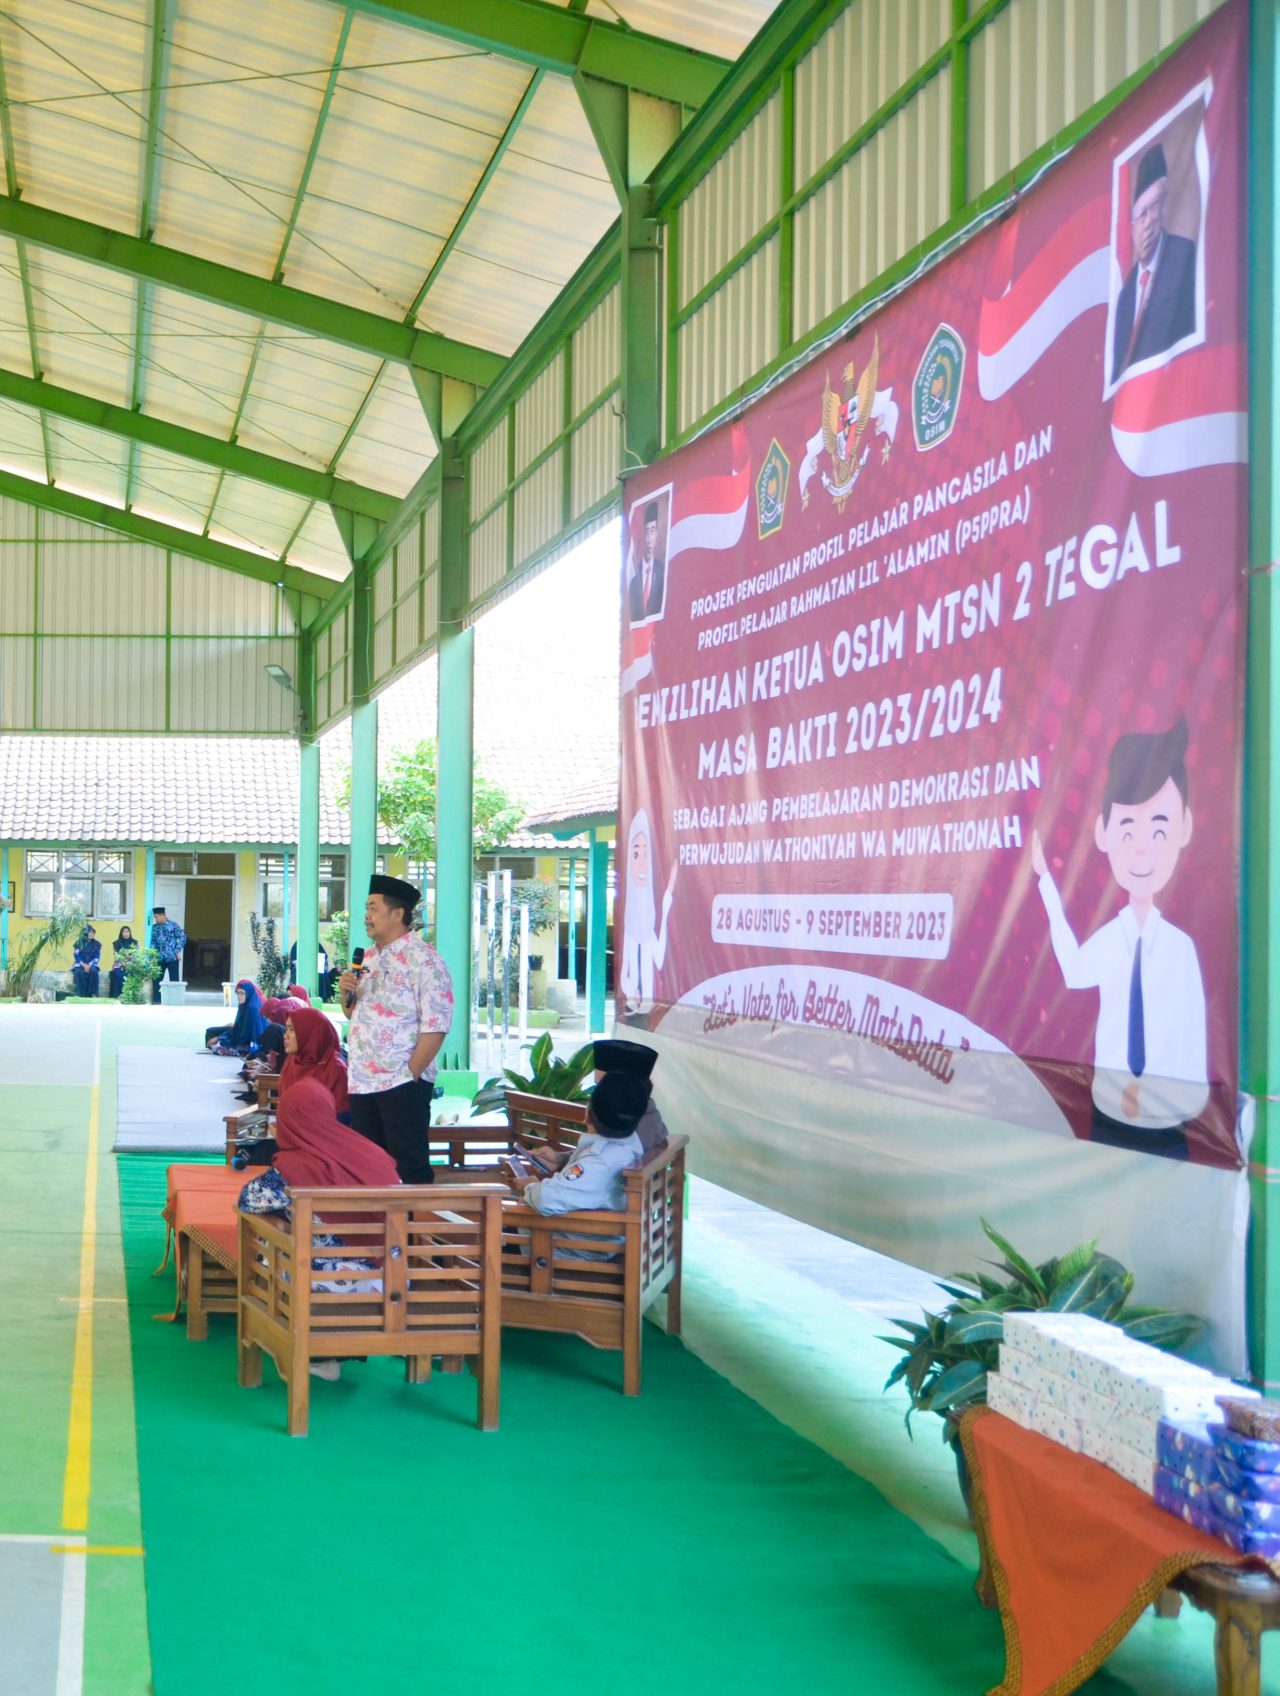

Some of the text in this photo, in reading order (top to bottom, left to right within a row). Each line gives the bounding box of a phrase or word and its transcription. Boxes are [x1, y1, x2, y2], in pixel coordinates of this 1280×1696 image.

[924, 422, 946, 442] OSIM
[690, 424, 1053, 620] PROJEK PENGUATAN PROFIL PELAJAR PANCASILA DAN
[697, 484, 1031, 651] PROFIL PELAJAR RAHMATAN LIL 'ALAMIN (P5PPRA)
[634, 499, 1182, 729] EMILIHAN KETUA OSIM MTSN 2 TEGAL
[697, 666, 1002, 781] MASA BAKTI 2023/2024
[672, 755, 1041, 831] SEBAGAI AJANG PEMBELAJARAN DEMOKRASI DAN
[679, 814, 1022, 866] PERWUJUDAN WATHONIYAH WA MUWATHONAH
[716, 907, 732, 930] 28
[735, 908, 791, 933] AGUSTUS
[806, 909, 814, 935] 9
[818, 909, 902, 939] SEPTEMBER
[905, 911, 946, 942] 2023
[742, 981, 773, 1022] Vote
[771, 977, 800, 1032] for
[802, 979, 856, 1034] Better
